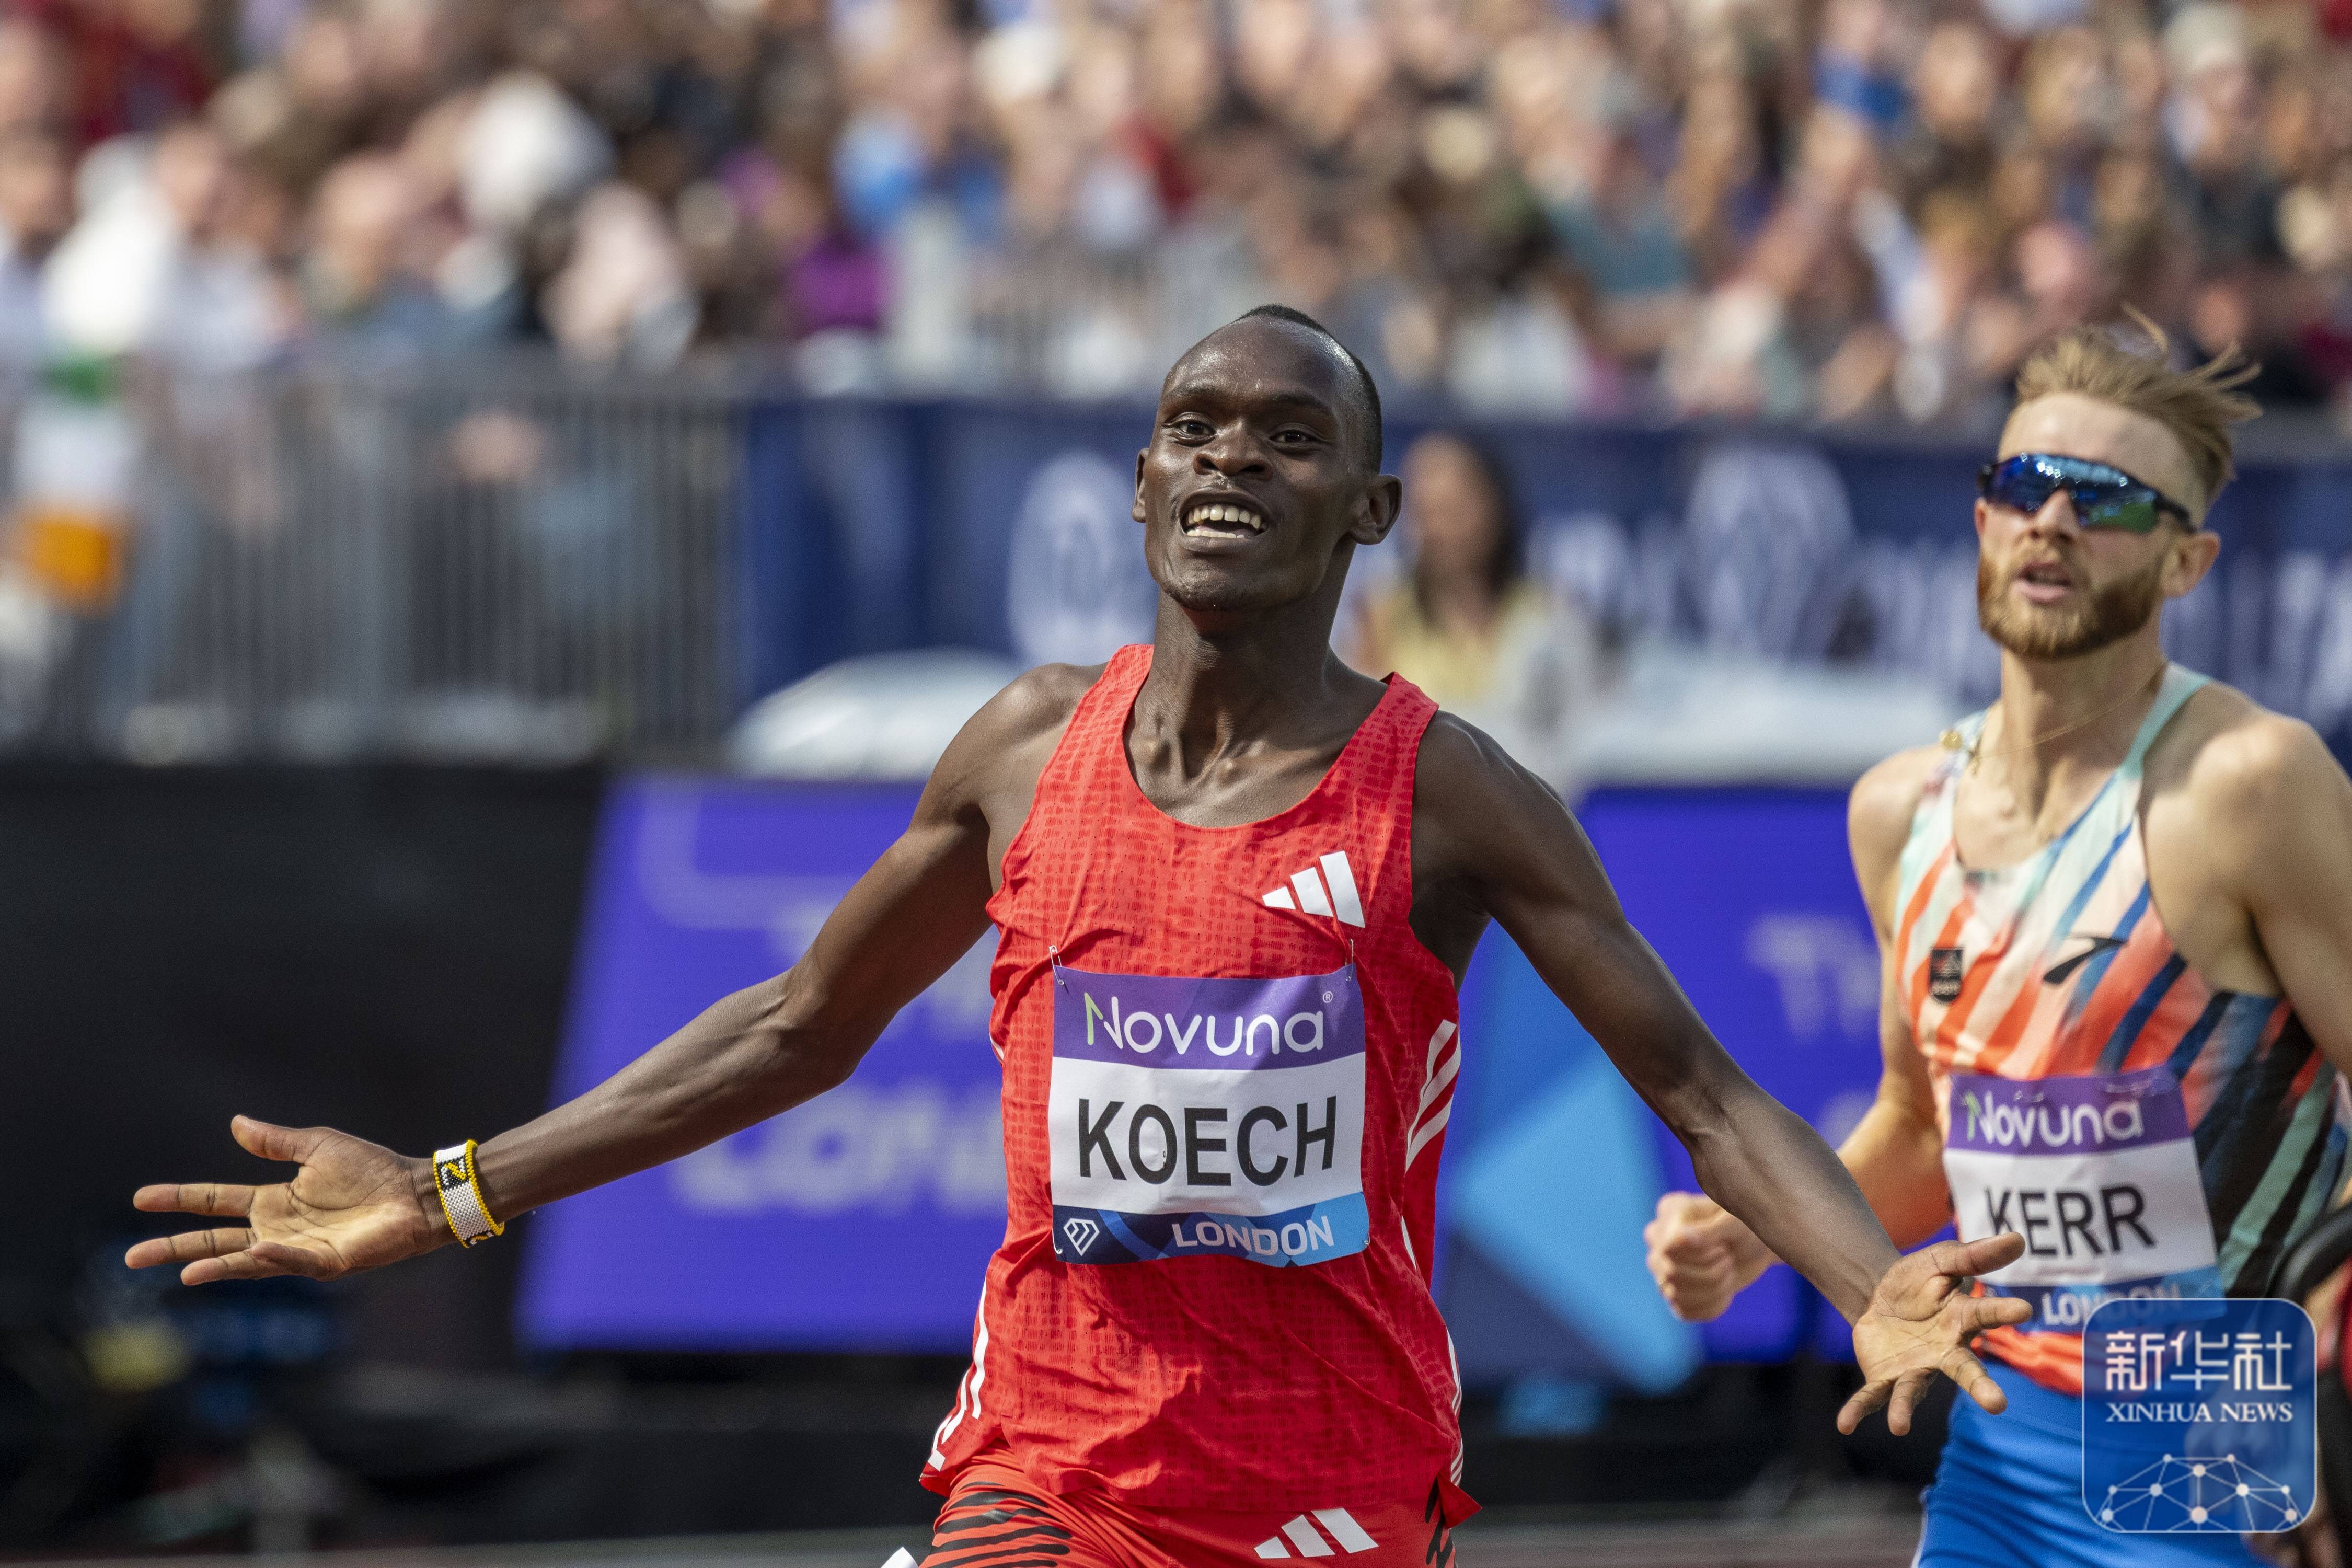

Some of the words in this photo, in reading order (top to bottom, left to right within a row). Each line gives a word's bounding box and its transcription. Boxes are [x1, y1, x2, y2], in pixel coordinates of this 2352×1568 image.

[1078, 1095, 1337, 1186] KOECH
[1961, 1091, 2144, 1146] Novuna
[1172, 1215, 1335, 1256] LONDON
[1985, 1183, 2156, 1257] KERR
